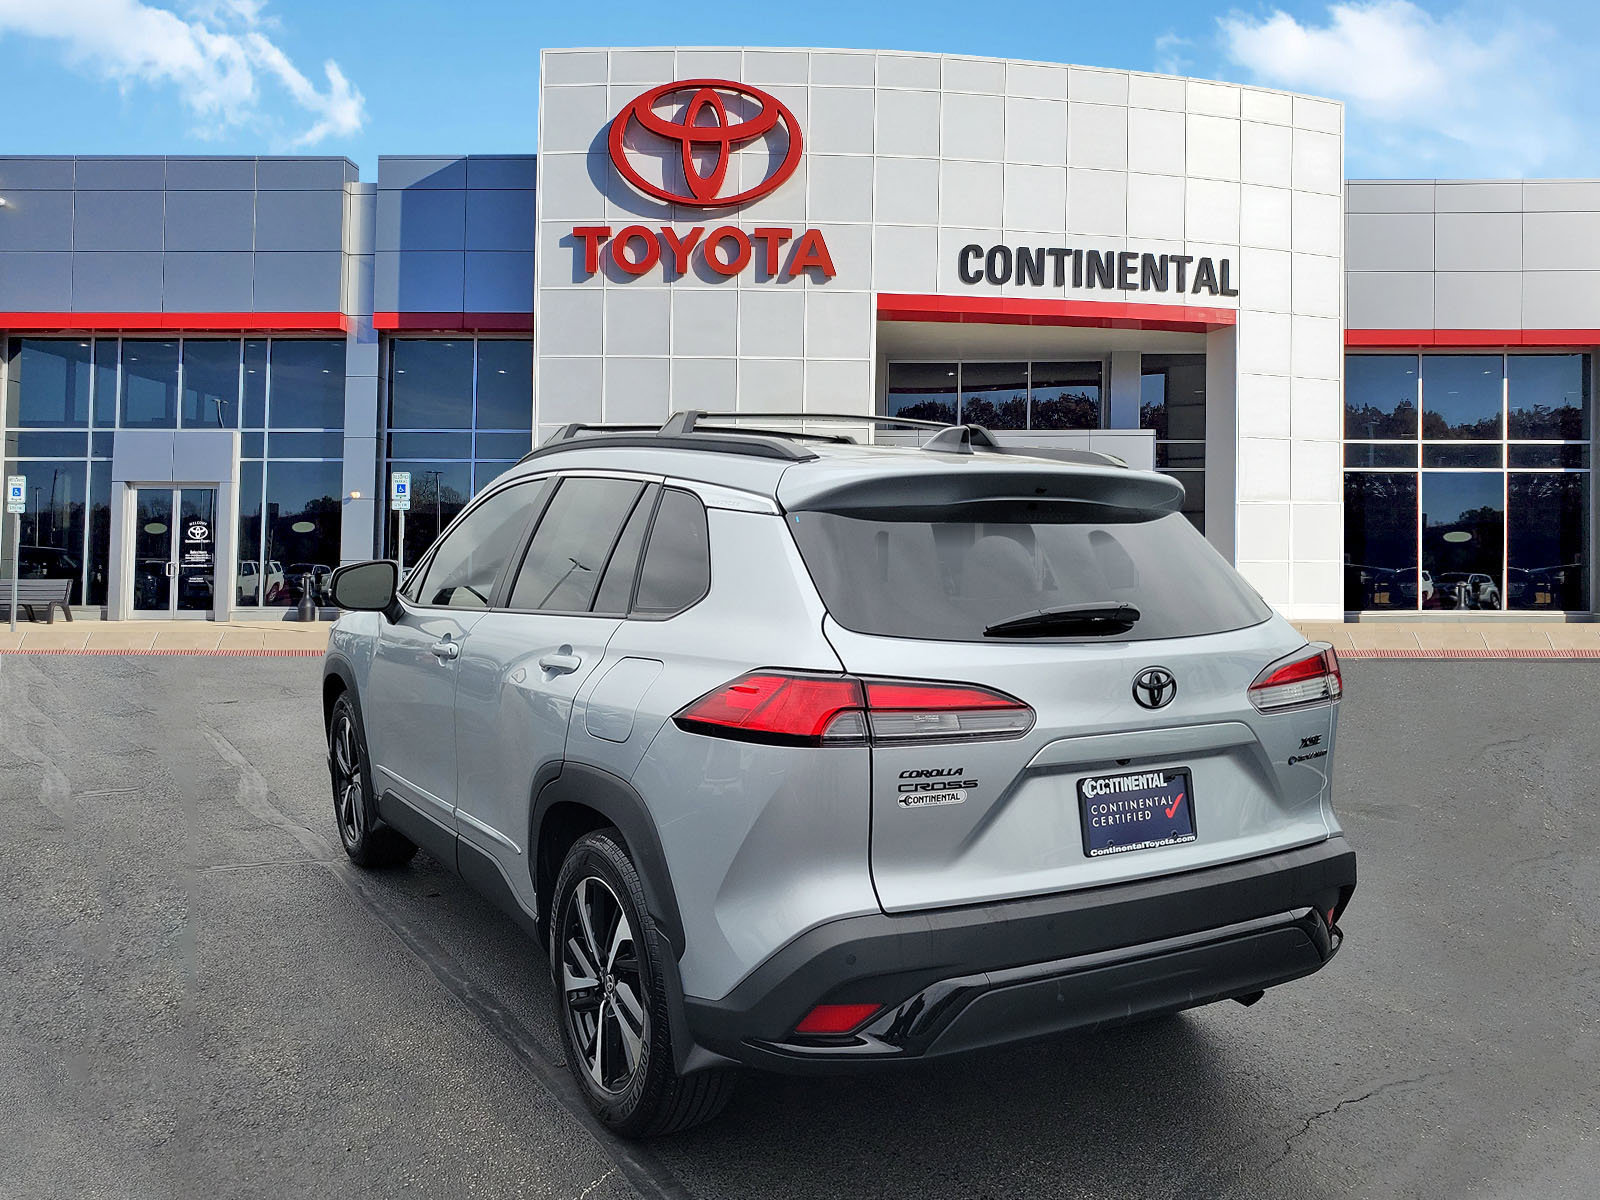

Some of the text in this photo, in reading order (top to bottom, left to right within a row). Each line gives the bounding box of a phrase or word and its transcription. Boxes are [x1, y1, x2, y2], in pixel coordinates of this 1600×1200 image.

[573, 225, 836, 277] TOYOTA
[958, 244, 1239, 297] CONTINENTAL
[898, 767, 964, 779] COROLLA
[897, 779, 979, 793] CROSS
[1082, 772, 1168, 799] CONTINENTAL
[904, 792, 961, 806] CONTINENTAL
[1090, 795, 1173, 815] CONTINENTAL
[1092, 810, 1152, 827] CERTIFIED
[1090, 834, 1196, 857] ContinentalToyota.com
